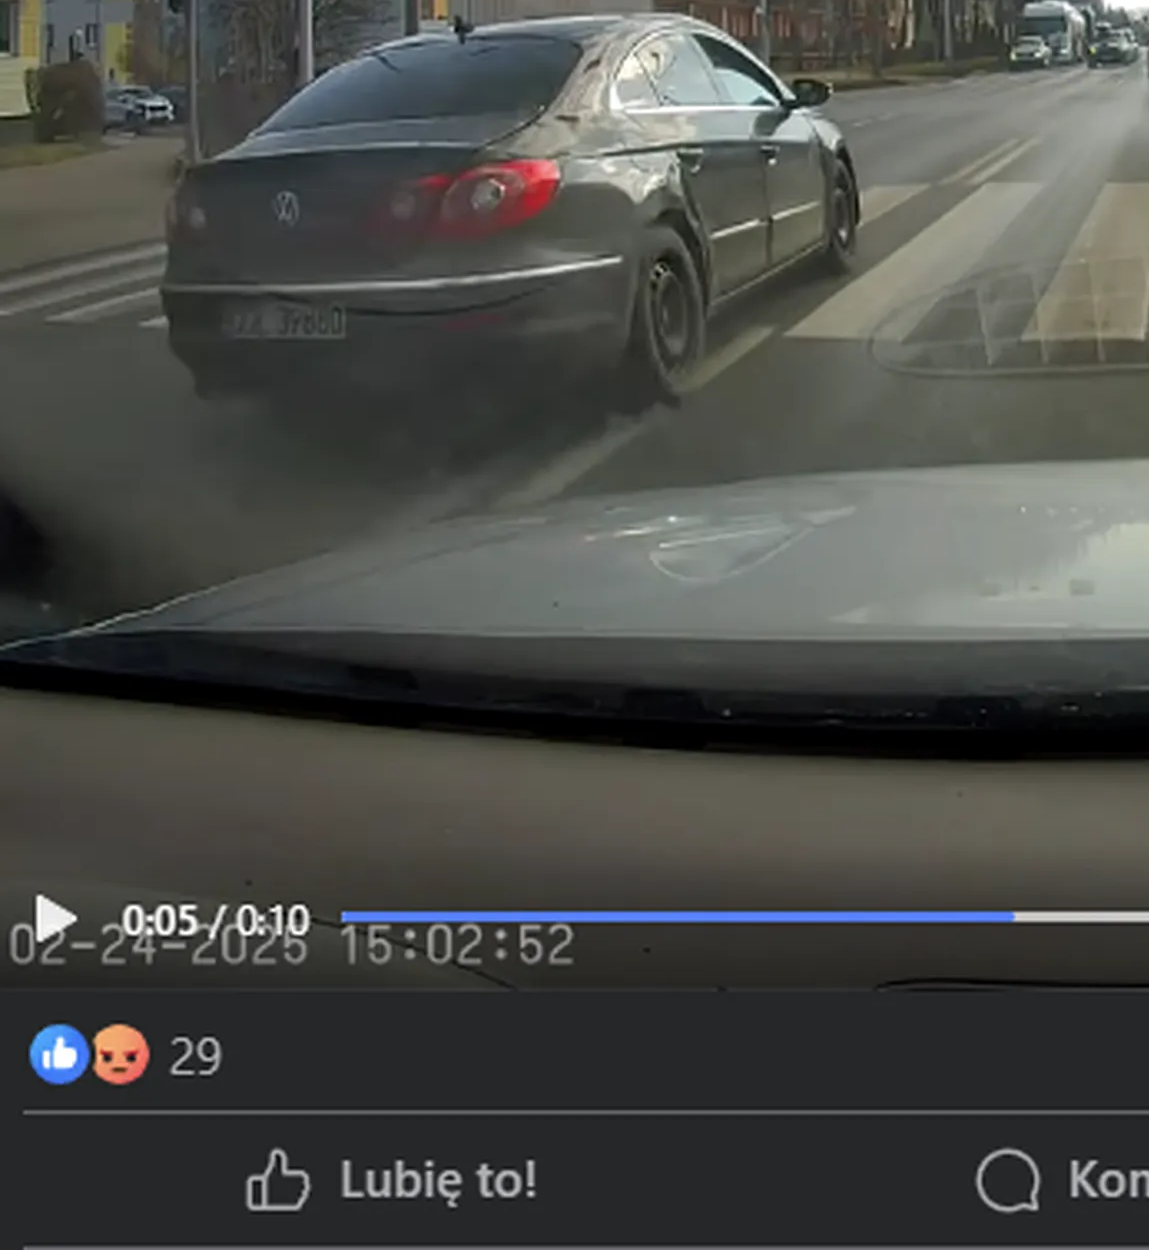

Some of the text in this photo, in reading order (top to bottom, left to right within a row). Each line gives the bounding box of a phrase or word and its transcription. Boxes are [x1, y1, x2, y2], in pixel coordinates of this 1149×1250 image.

[170, 1037, 221, 1075] 29
[342, 1160, 535, 1207] Lubię to!
